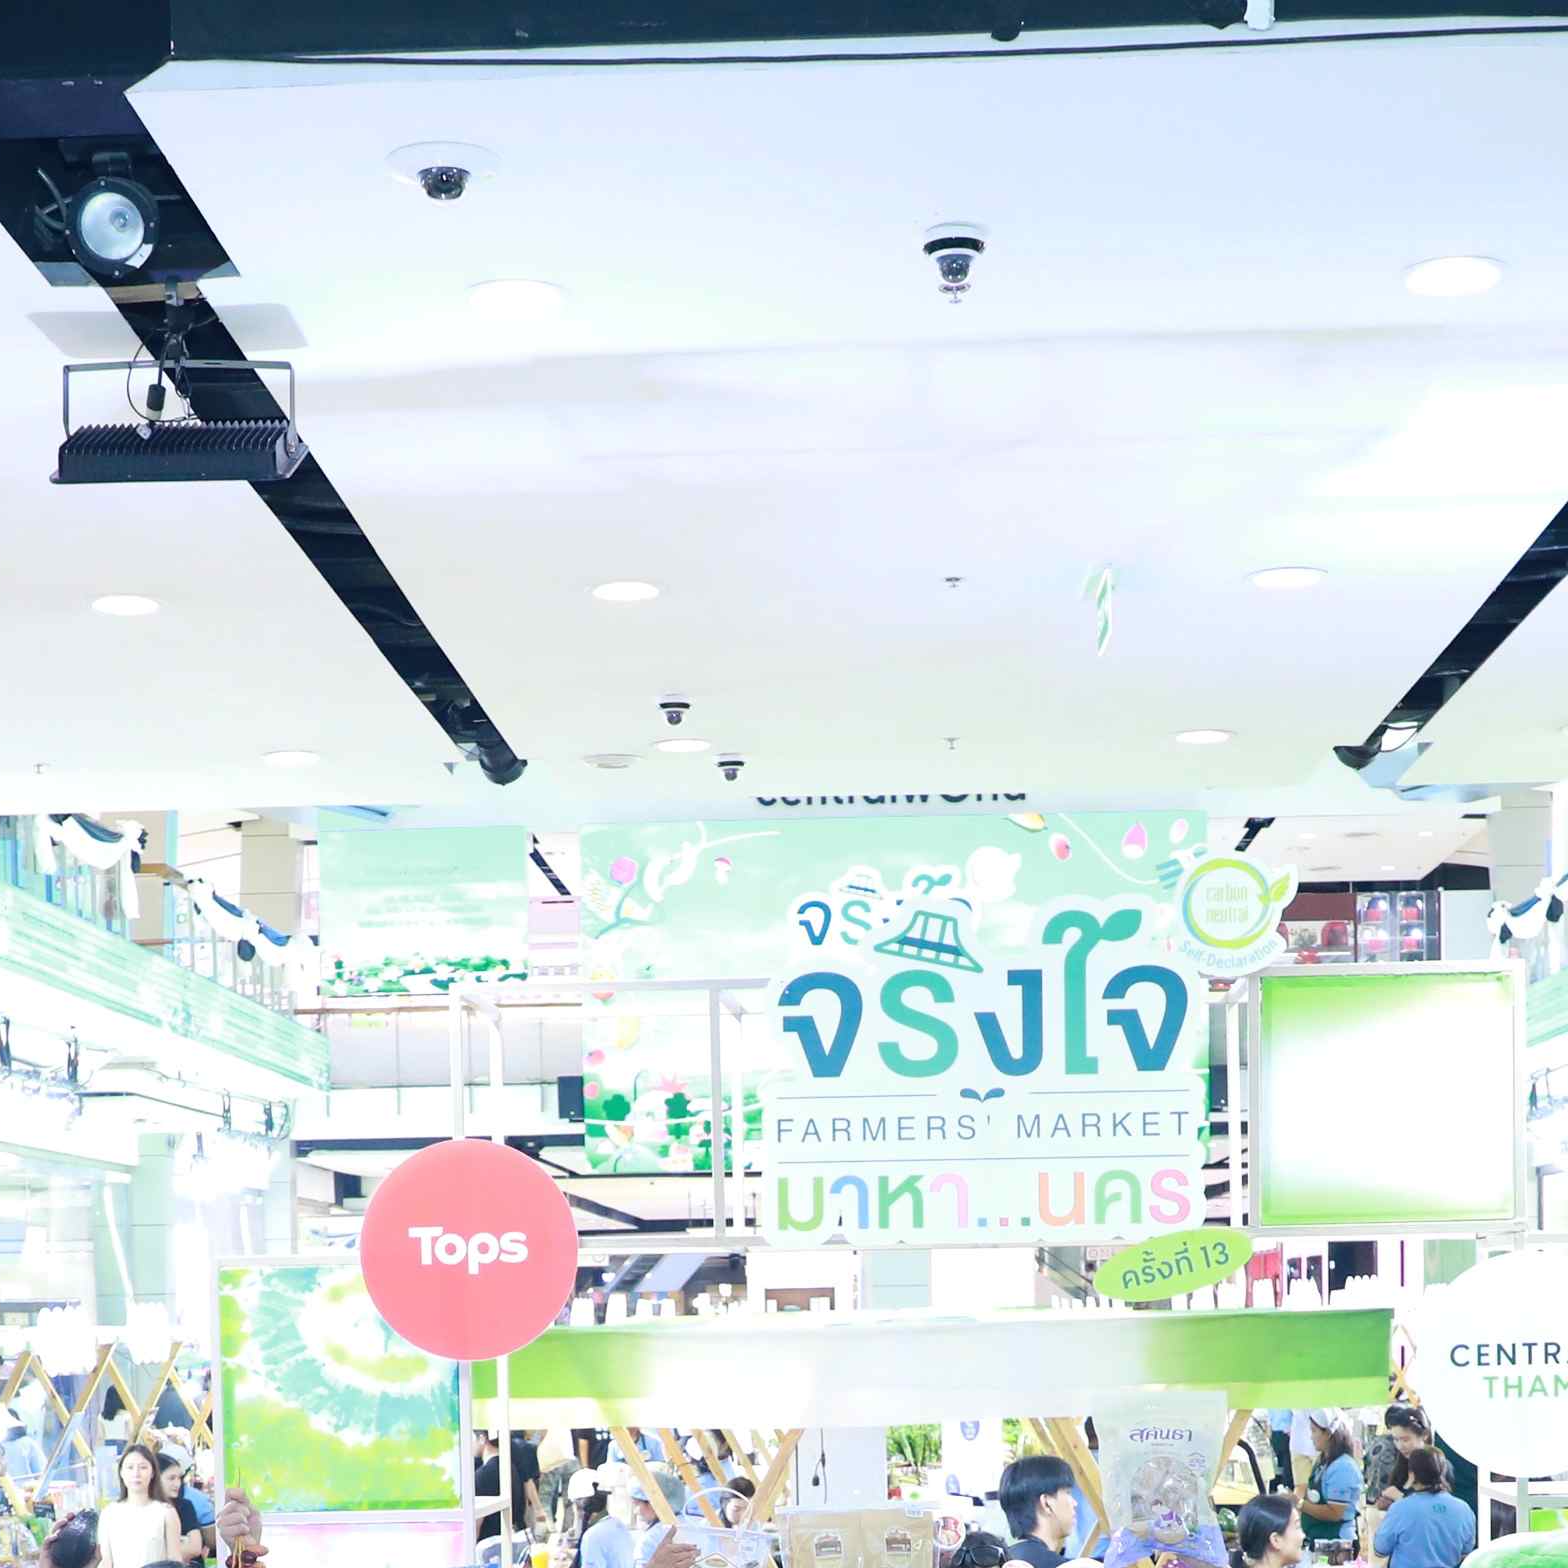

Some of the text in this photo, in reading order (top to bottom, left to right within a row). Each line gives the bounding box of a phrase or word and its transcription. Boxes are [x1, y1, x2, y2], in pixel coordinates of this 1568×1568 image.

[776, 1111, 1190, 1143] FARMERS' MARKET
[408, 1226, 529, 1275] Tops
[1120, 1241, 1231, 1290] ครั้งที่ 13
